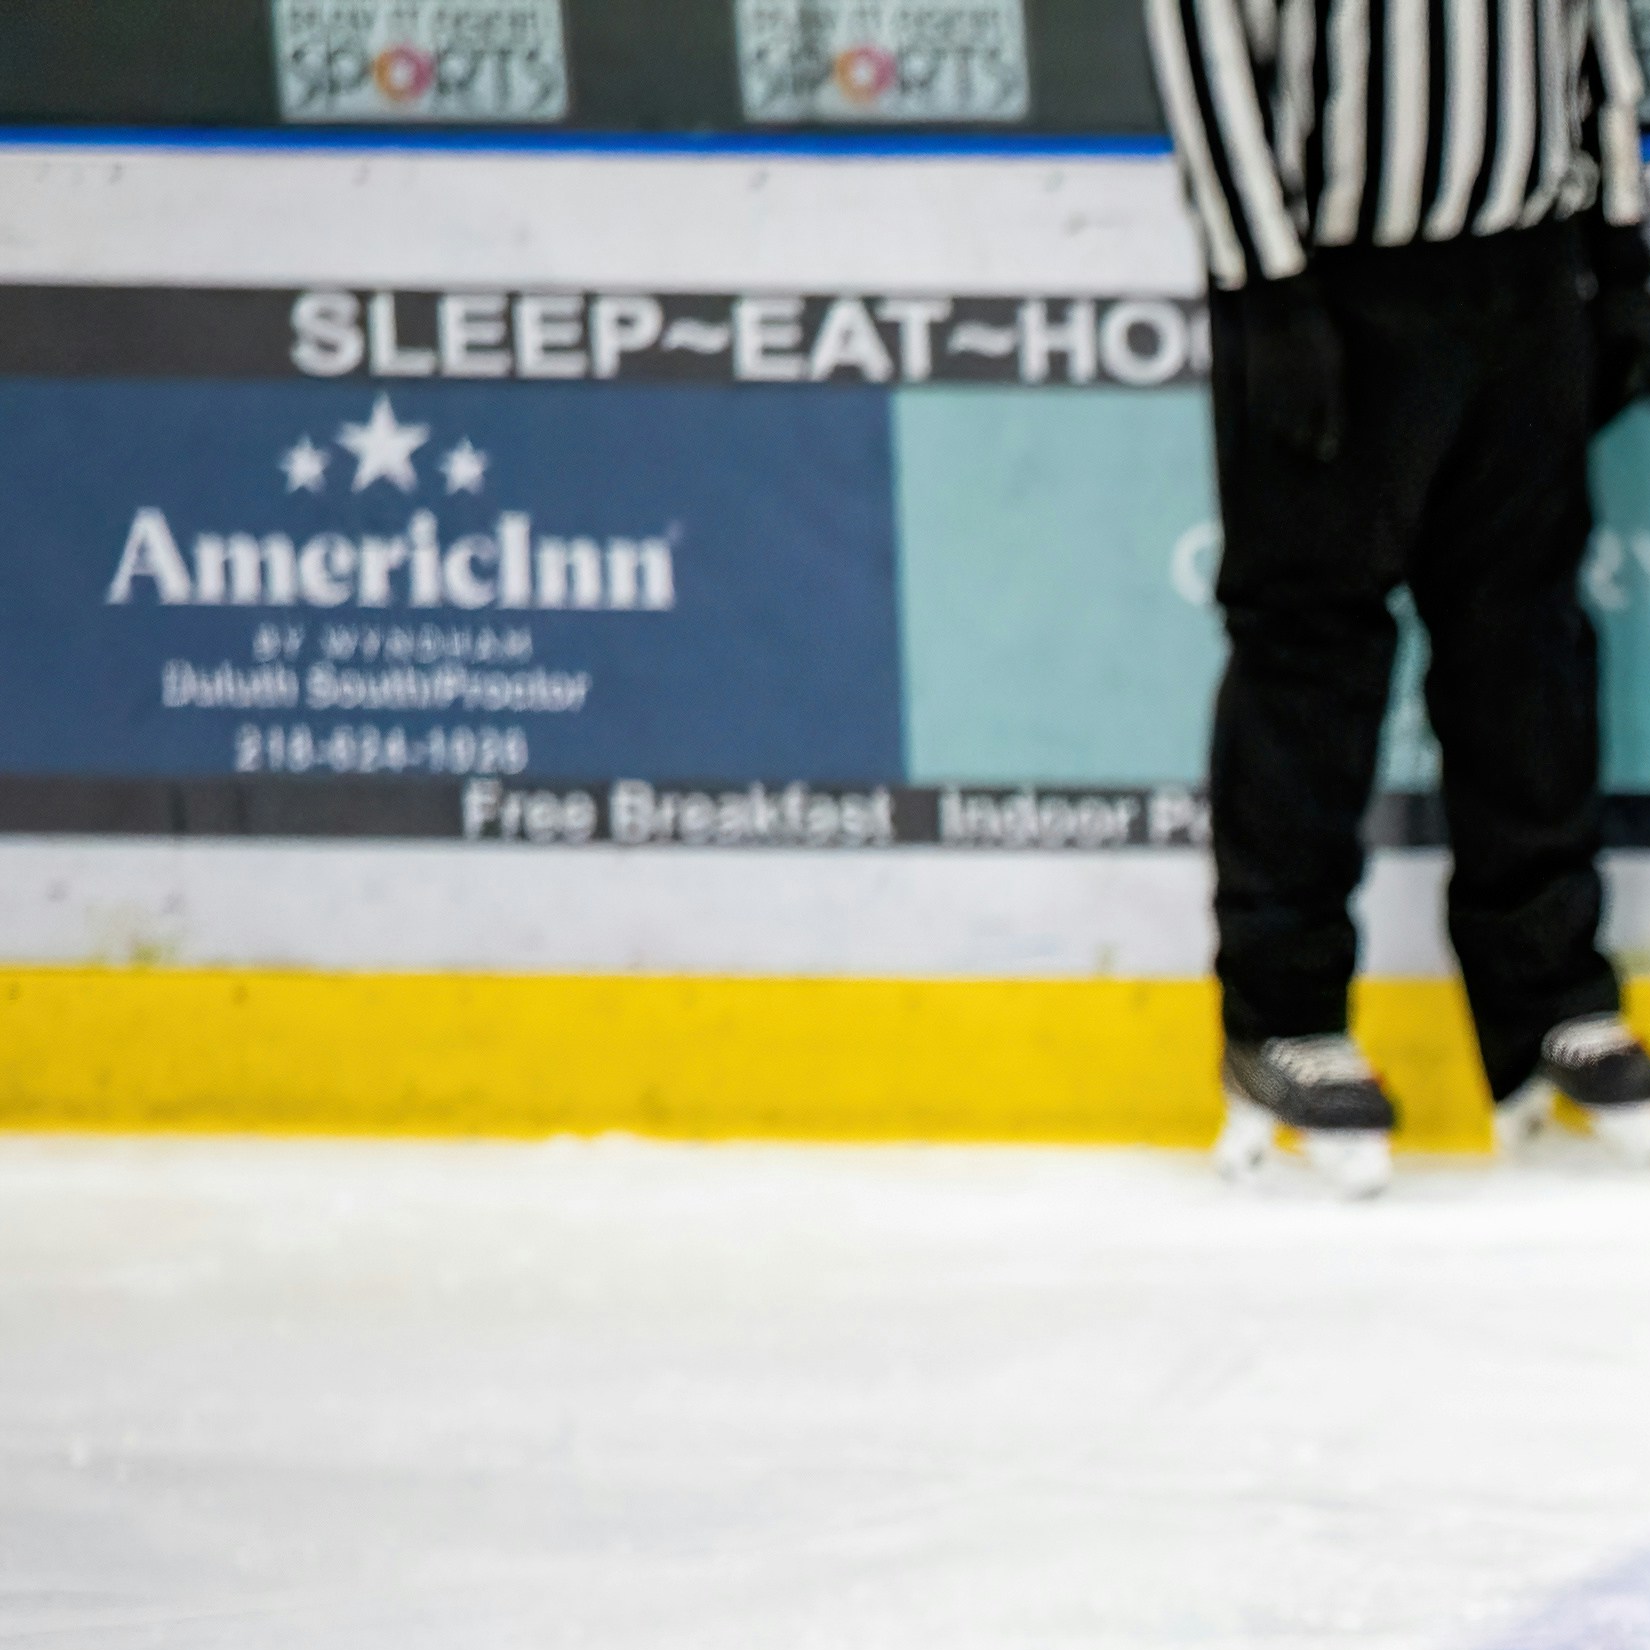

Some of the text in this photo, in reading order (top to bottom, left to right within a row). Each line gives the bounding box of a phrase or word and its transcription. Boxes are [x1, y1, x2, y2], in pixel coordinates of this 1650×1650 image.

[291, 291, 1211, 386] SLEEP~EAT~HO
[106, 507, 675, 610] AmericInn
[462, 778, 597, 844] Free
[610, 779, 893, 846] Breakfast
